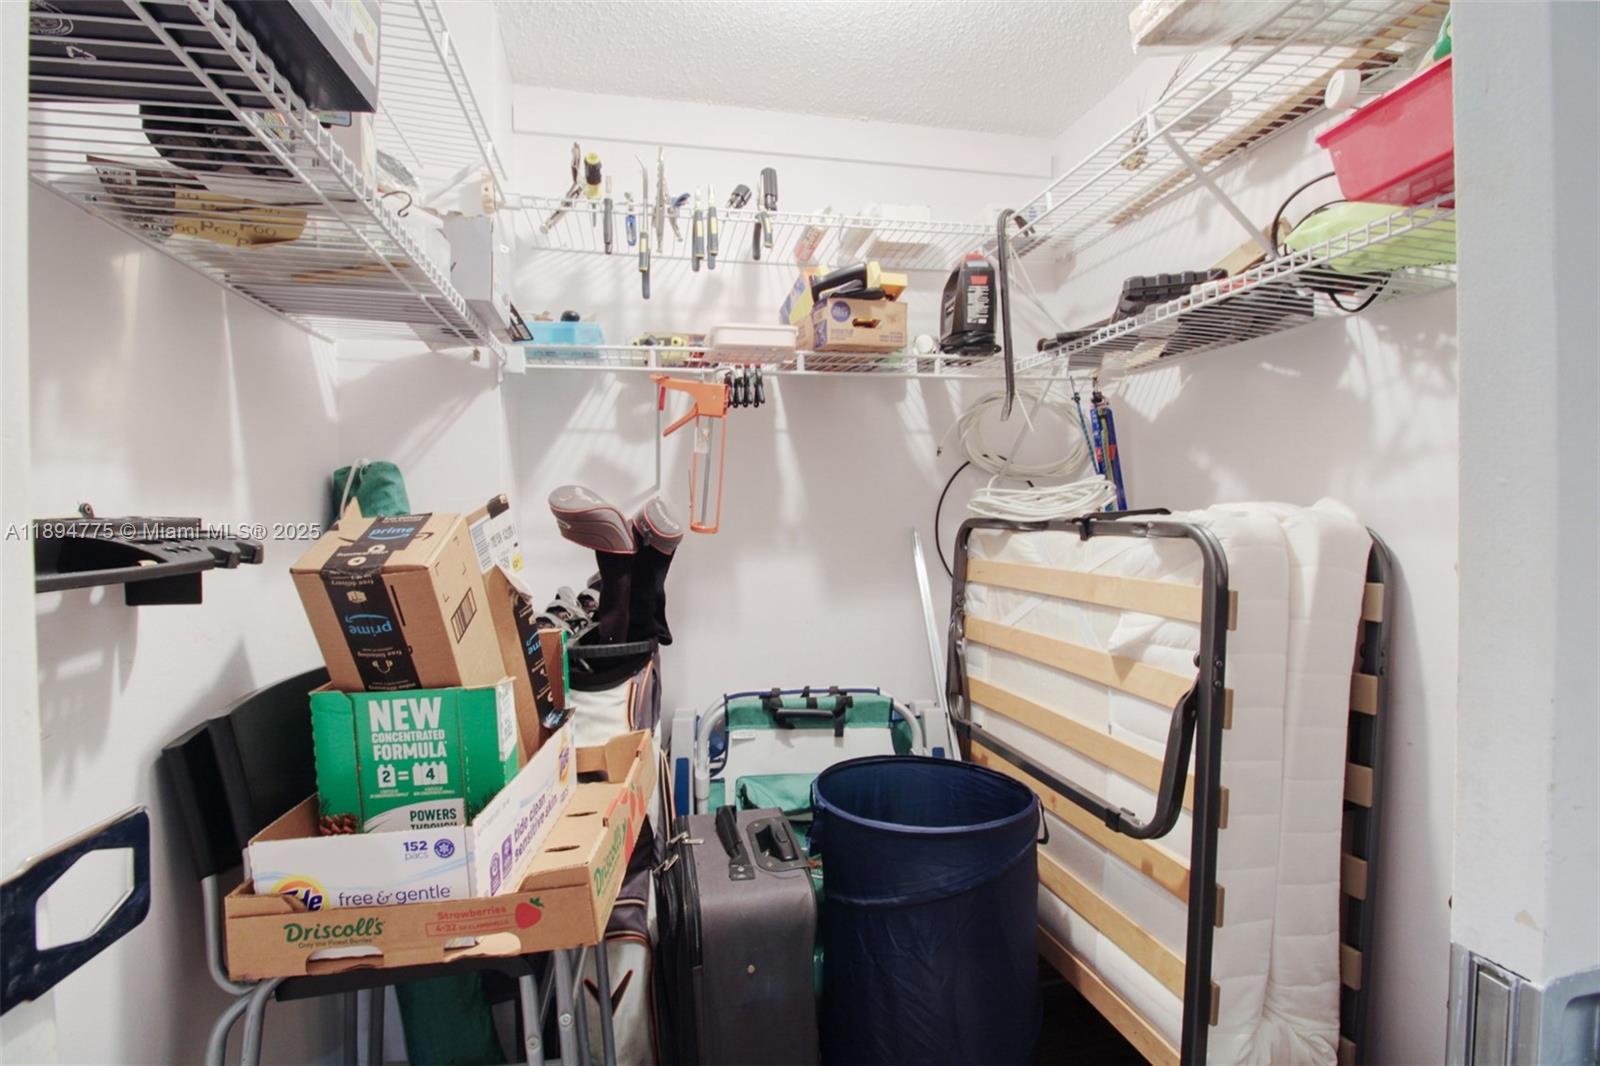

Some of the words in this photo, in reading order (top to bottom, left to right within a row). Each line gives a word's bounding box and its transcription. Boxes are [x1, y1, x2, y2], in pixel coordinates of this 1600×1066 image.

[368, 527, 415, 538] prime
[348, 620, 393, 637] prime
[368, 697, 442, 732] NEW
[371, 729, 446, 744] CONCENTRATED
[373, 741, 448, 762] FORMULA
[382, 770, 391, 783] 2
[426, 768, 435, 780] 4
[410, 808, 457, 822] POWERS
[403, 841, 428, 852] 152
[404, 850, 430, 861] pacs
[279, 889, 322, 911] Tde
[338, 892, 373, 907] free
[376, 890, 393, 906] &
[395, 885, 451, 906] gentle
[437, 905, 507, 920] Strawberries
[283, 917, 383, 943] Driscoll's
